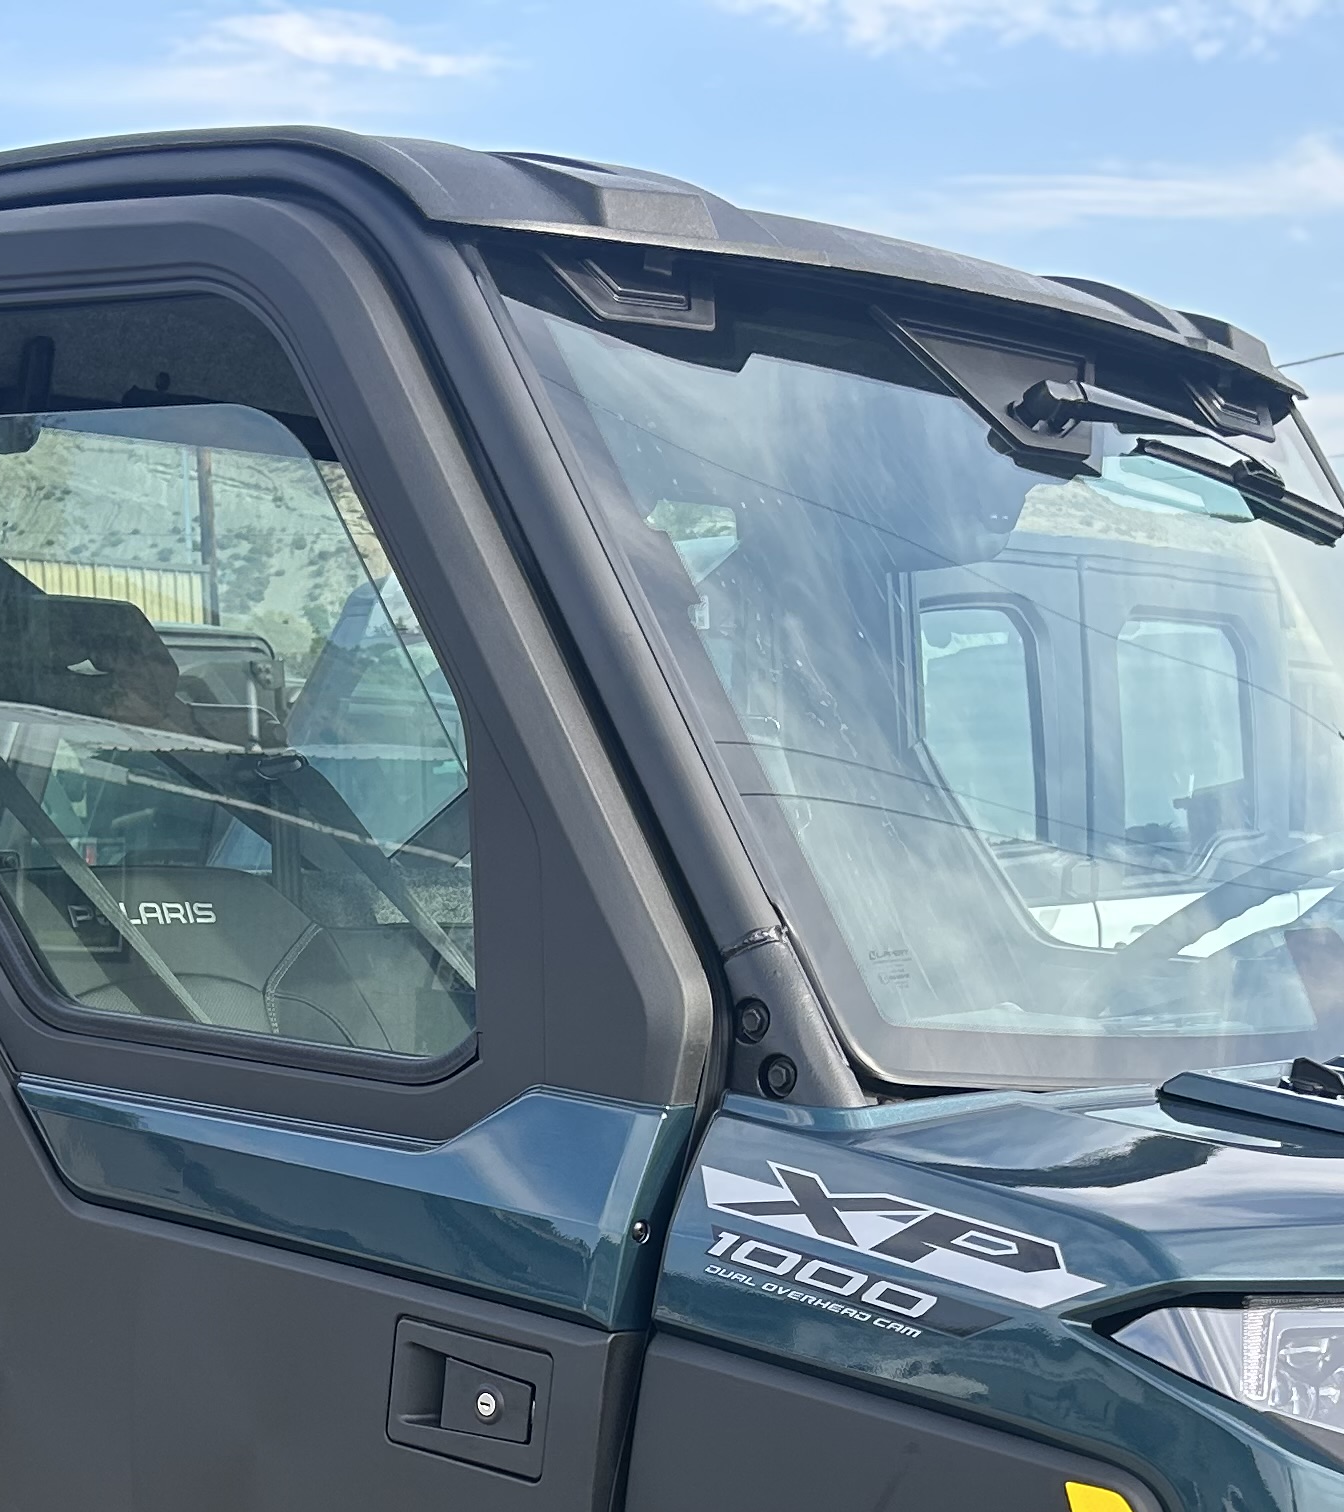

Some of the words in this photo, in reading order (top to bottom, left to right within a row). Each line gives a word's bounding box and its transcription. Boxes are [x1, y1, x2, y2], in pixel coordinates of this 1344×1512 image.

[709, 1160, 1067, 1273] XP
[703, 1263, 757, 1288] DUAL
[761, 1281, 872, 1325] OVERHEAD
[873, 1316, 922, 1339] CAM
[706, 1230, 938, 1319] 1000
